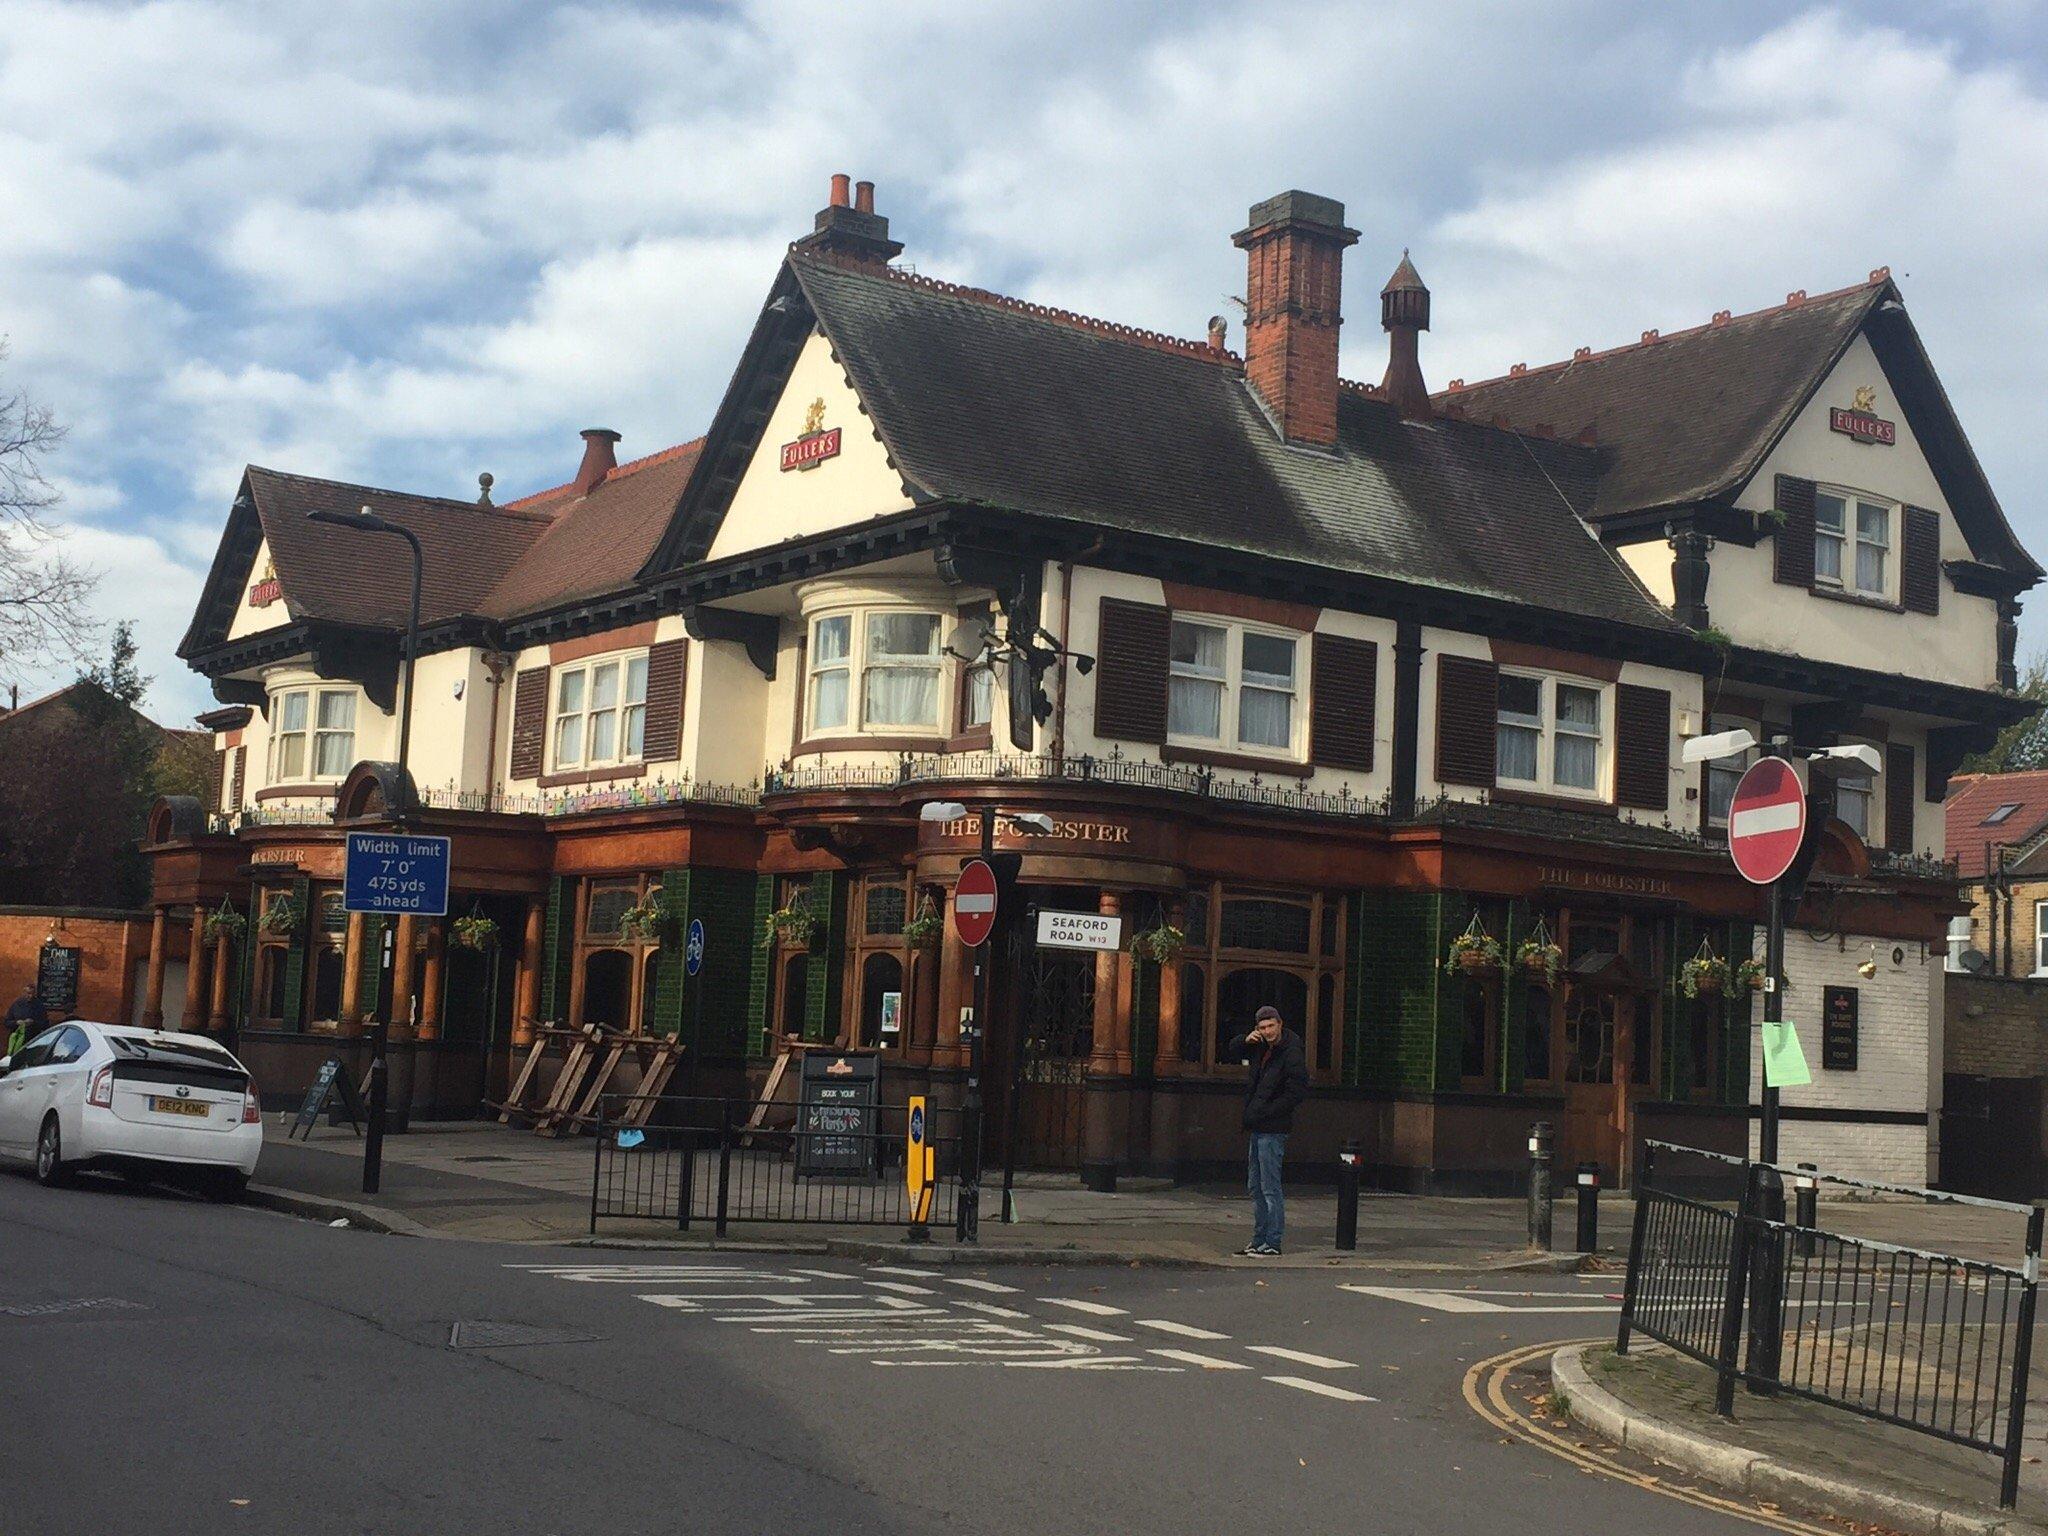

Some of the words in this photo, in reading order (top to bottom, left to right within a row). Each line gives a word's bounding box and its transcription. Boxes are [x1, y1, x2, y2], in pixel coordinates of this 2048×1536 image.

[1837, 412, 1892, 439] FULLER'S
[783, 436, 833, 464] FULLER'S
[939, 818, 980, 837] THE
[993, 818, 1131, 843] FOESTER
[357, 839, 399, 854] Width
[407, 842, 441, 856] limit
[367, 877, 397, 891] 475
[400, 879, 426, 893] yds
[373, 894, 419, 908] ahead
[1052, 917, 1108, 931] SEAFORD
[1050, 931, 1083, 942] ROAD
